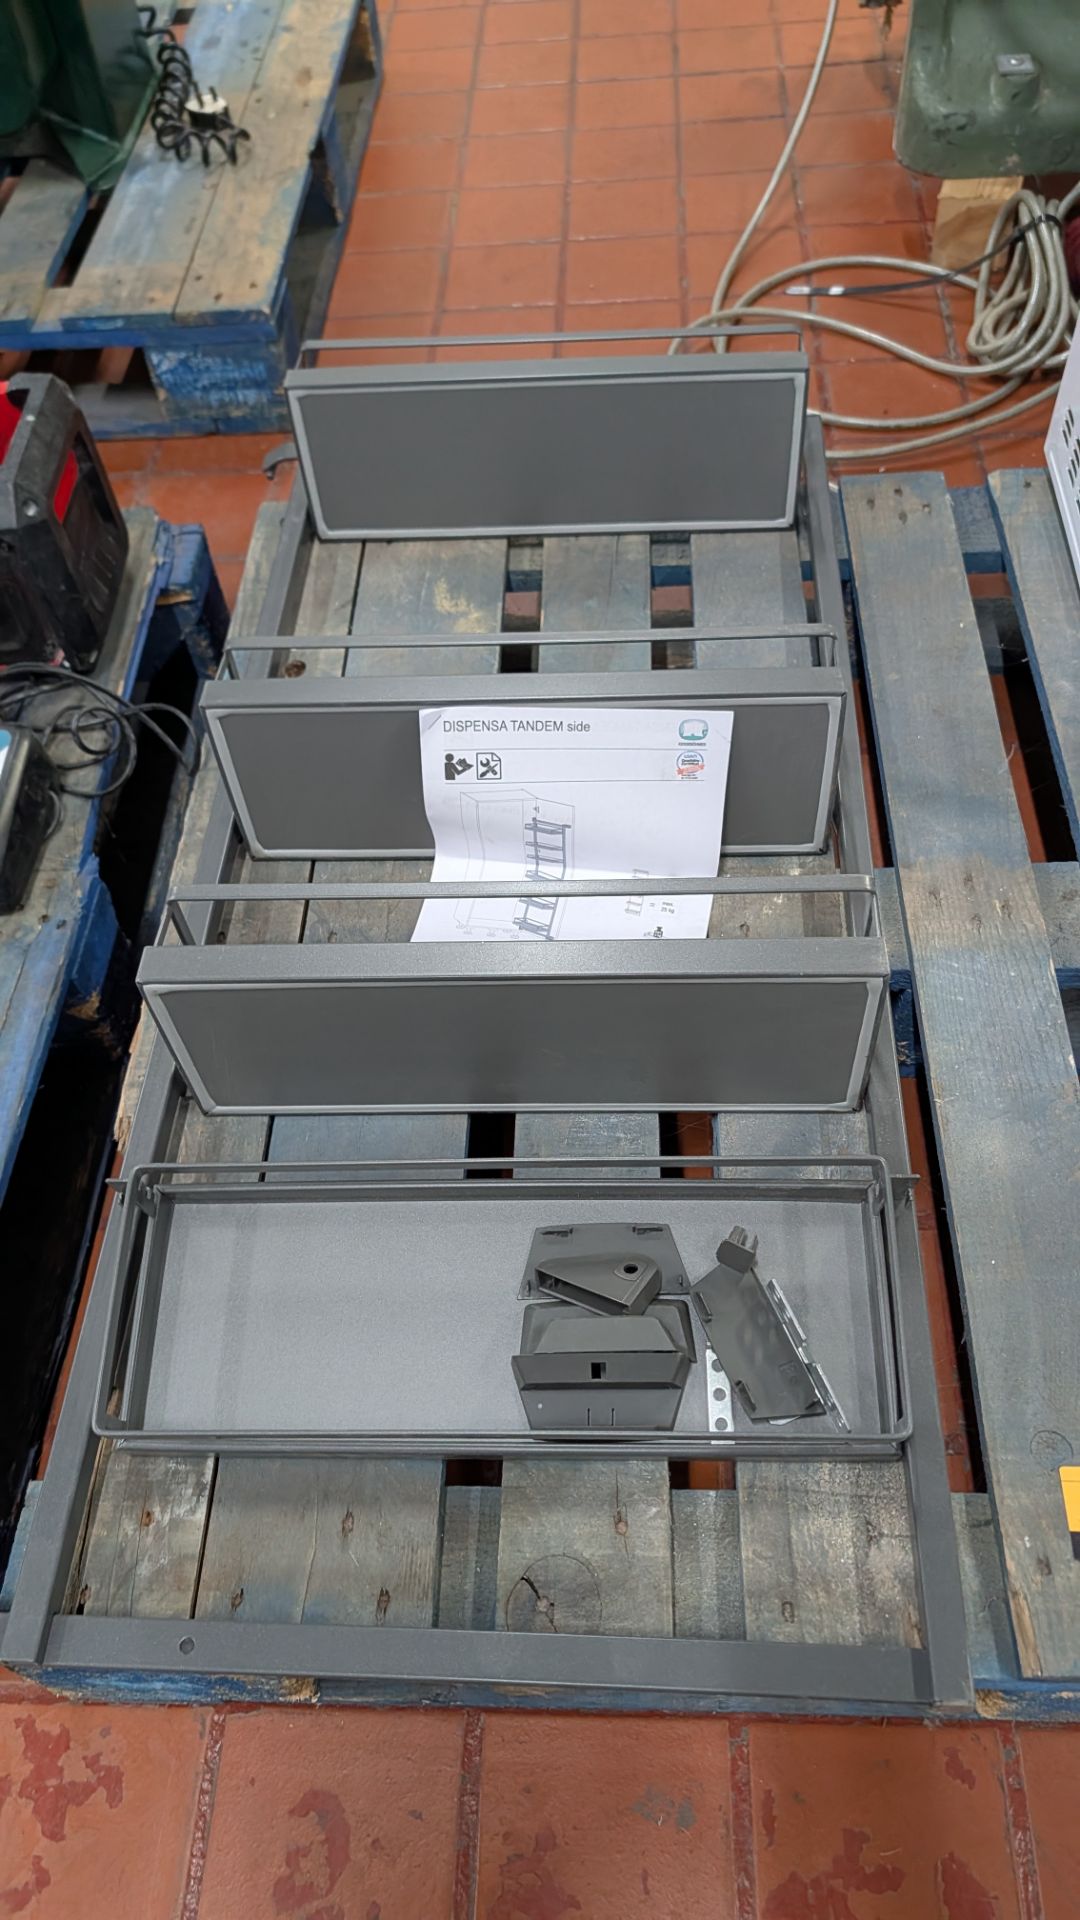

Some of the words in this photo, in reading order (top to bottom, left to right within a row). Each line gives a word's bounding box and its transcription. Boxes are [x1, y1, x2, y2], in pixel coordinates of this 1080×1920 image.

[443, 720, 508, 732] DISPENSA
[510, 720, 564, 732] TANDEM
[567, 721, 591, 732] side
